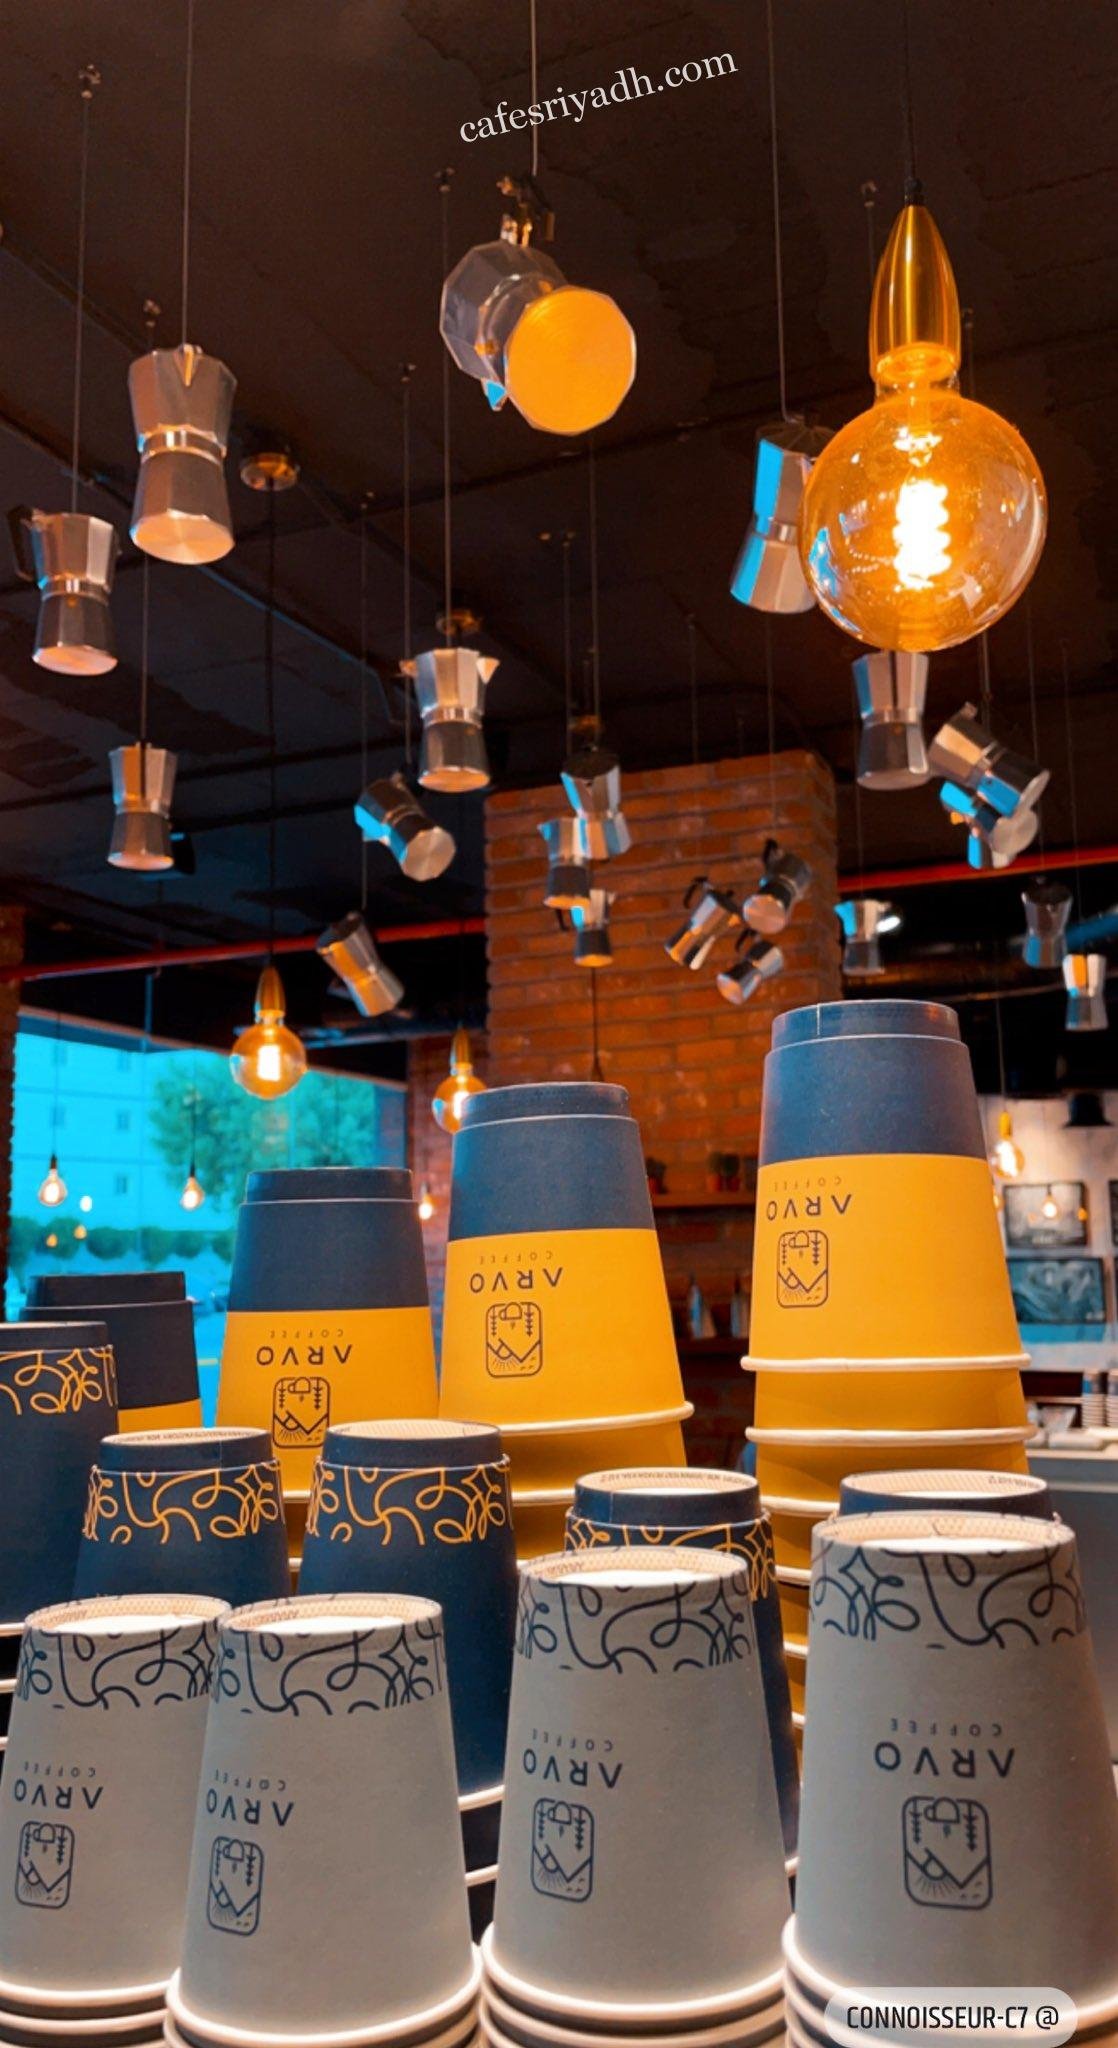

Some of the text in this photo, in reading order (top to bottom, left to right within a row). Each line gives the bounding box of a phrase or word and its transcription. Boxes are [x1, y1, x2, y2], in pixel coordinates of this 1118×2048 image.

[766, 1193, 852, 1221] ARVO
[469, 1267, 563, 1294] ARVO
[256, 1344, 352, 1366] ARVO
[891, 1717, 1003, 1737] COFFEE
[523, 1748, 623, 1789] ARVO
[874, 1741, 1016, 1778] ARVO
[14, 1778, 104, 1809] ARVO
[206, 1788, 294, 1827] ARVO
